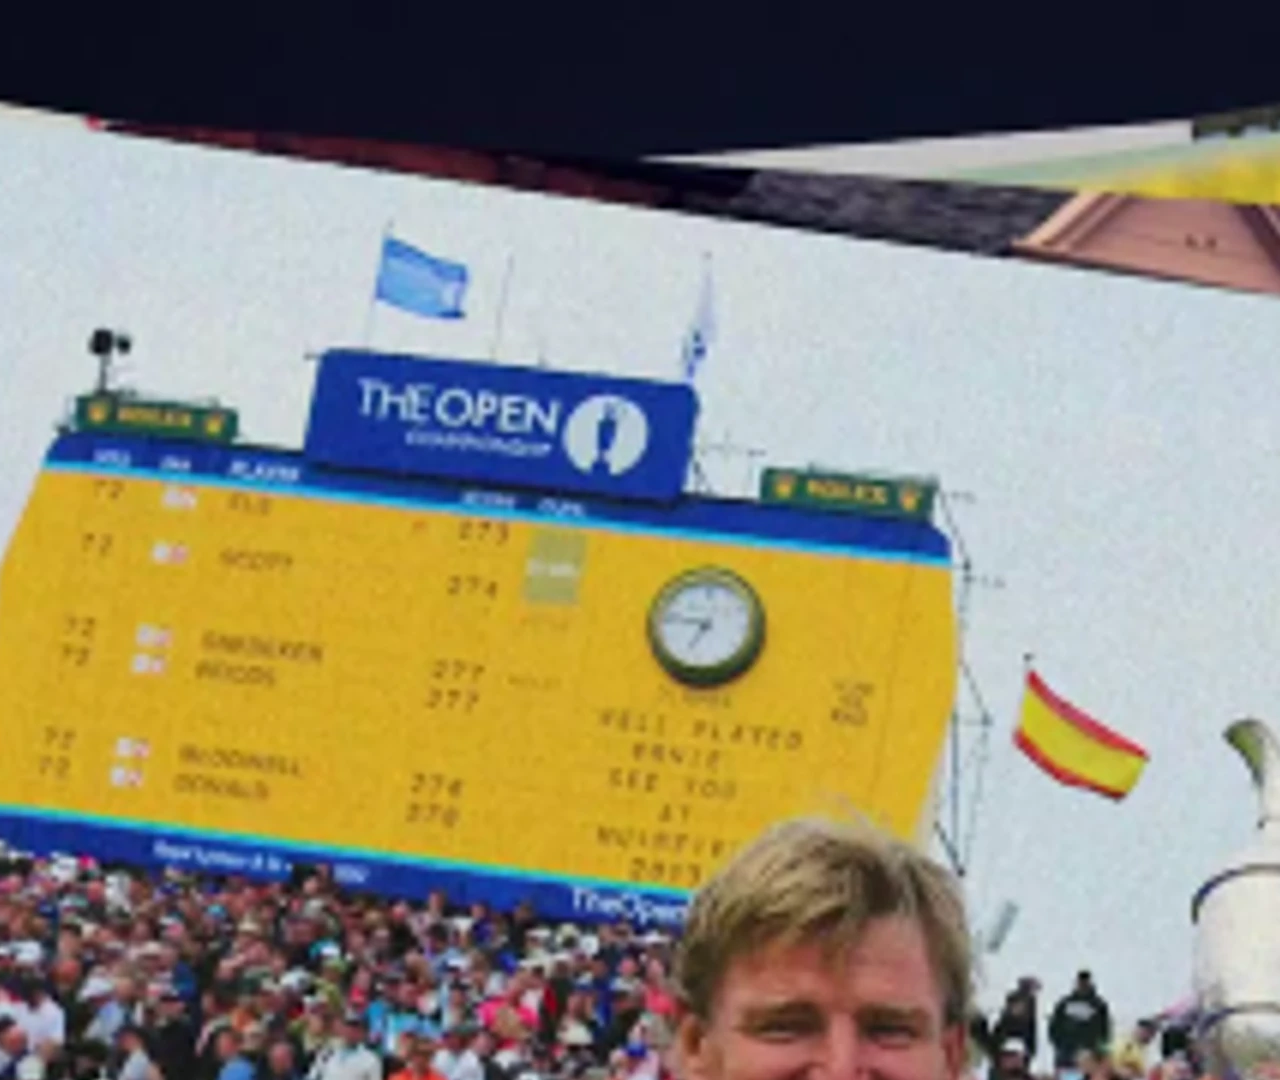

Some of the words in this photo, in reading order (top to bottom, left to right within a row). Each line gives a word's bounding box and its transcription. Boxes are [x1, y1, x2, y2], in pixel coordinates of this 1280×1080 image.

[357, 378, 434, 421] THE
[434, 388, 561, 434] OPEN
[657, 804, 690, 825] AT
